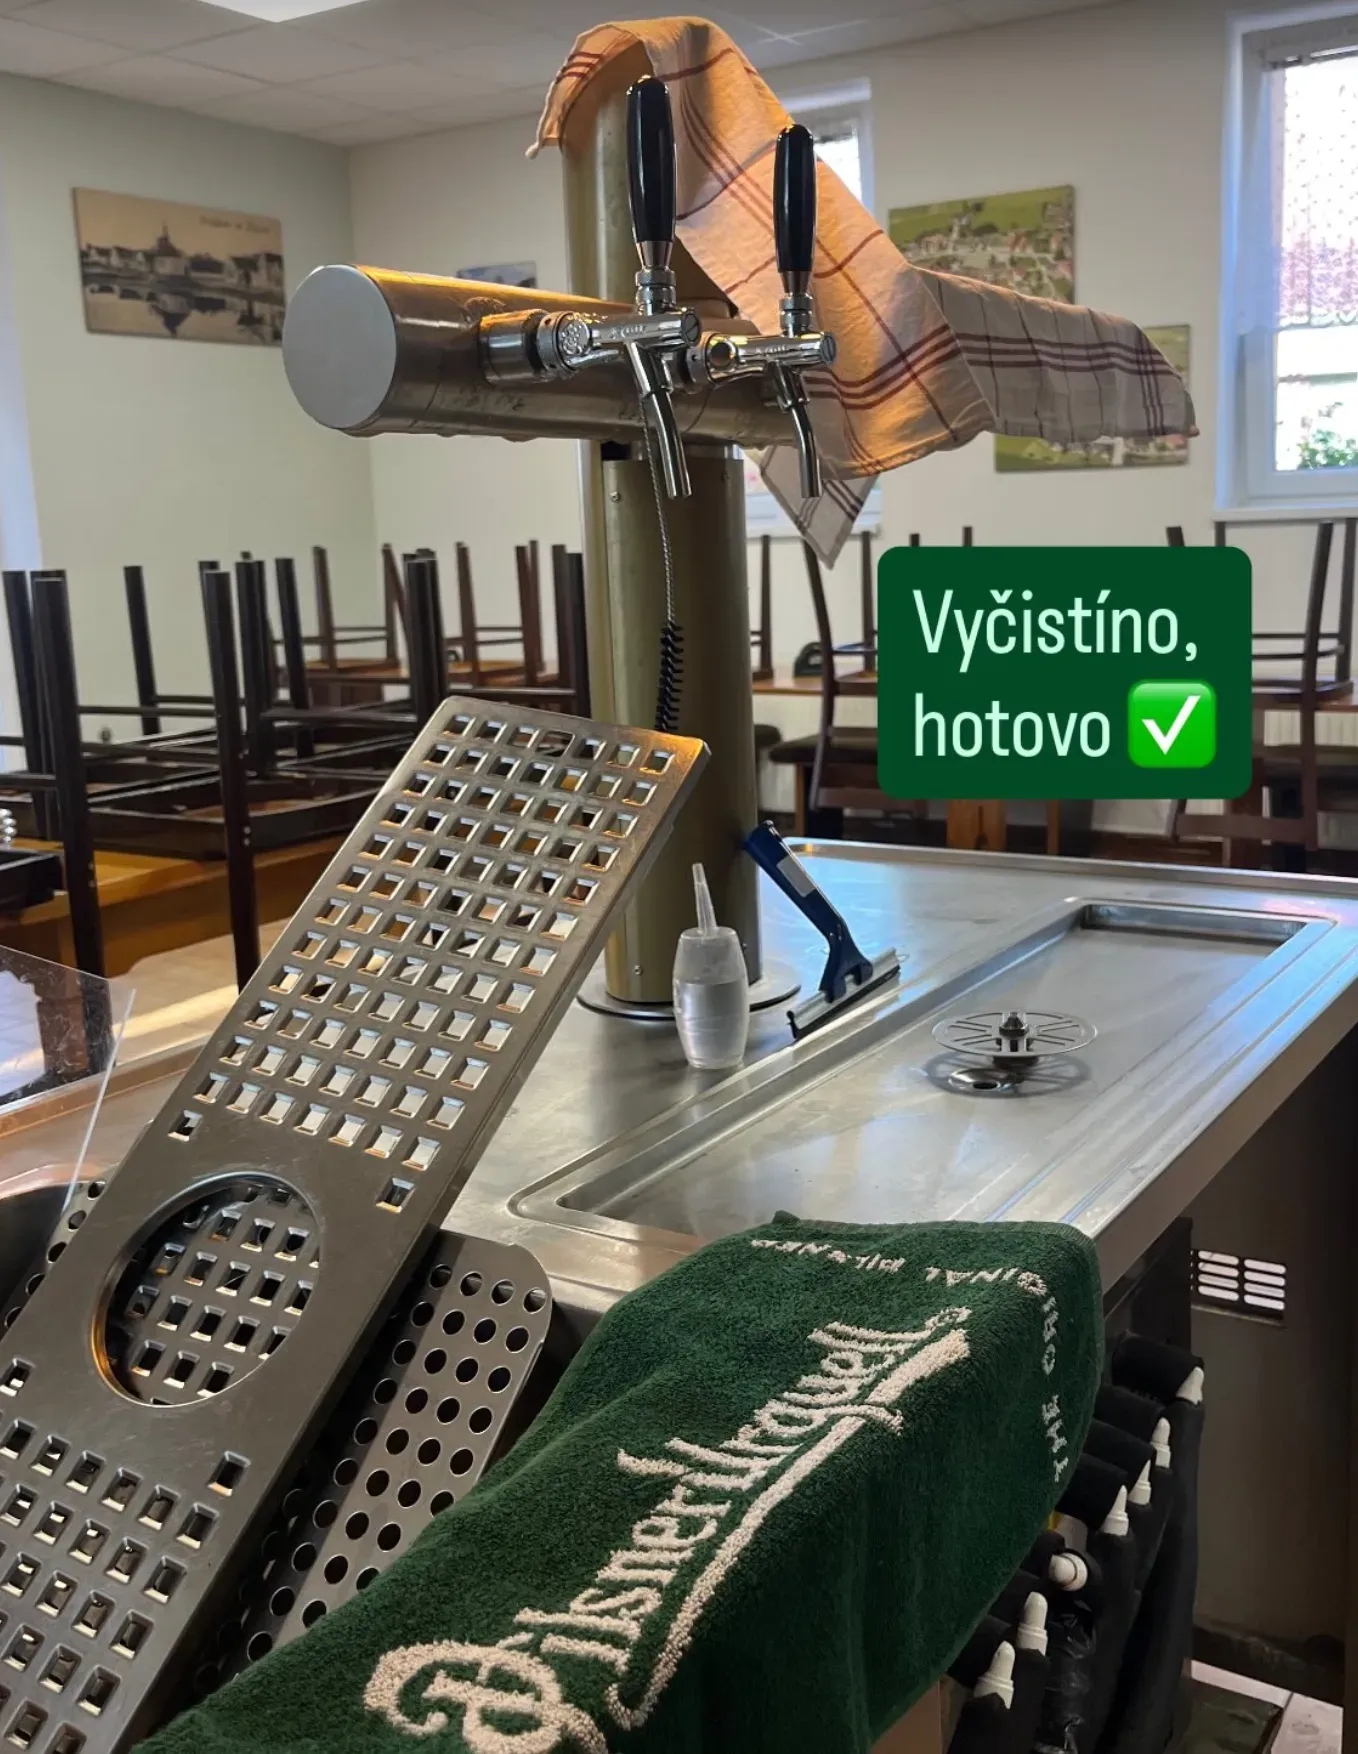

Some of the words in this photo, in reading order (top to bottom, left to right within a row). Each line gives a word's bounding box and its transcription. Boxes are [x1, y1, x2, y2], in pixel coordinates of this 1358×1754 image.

[925, 1265, 1060, 1376] ORIGINAL
[1041, 1394, 1069, 1483] THE
[362, 1484, 734, 1754] Pilsner
